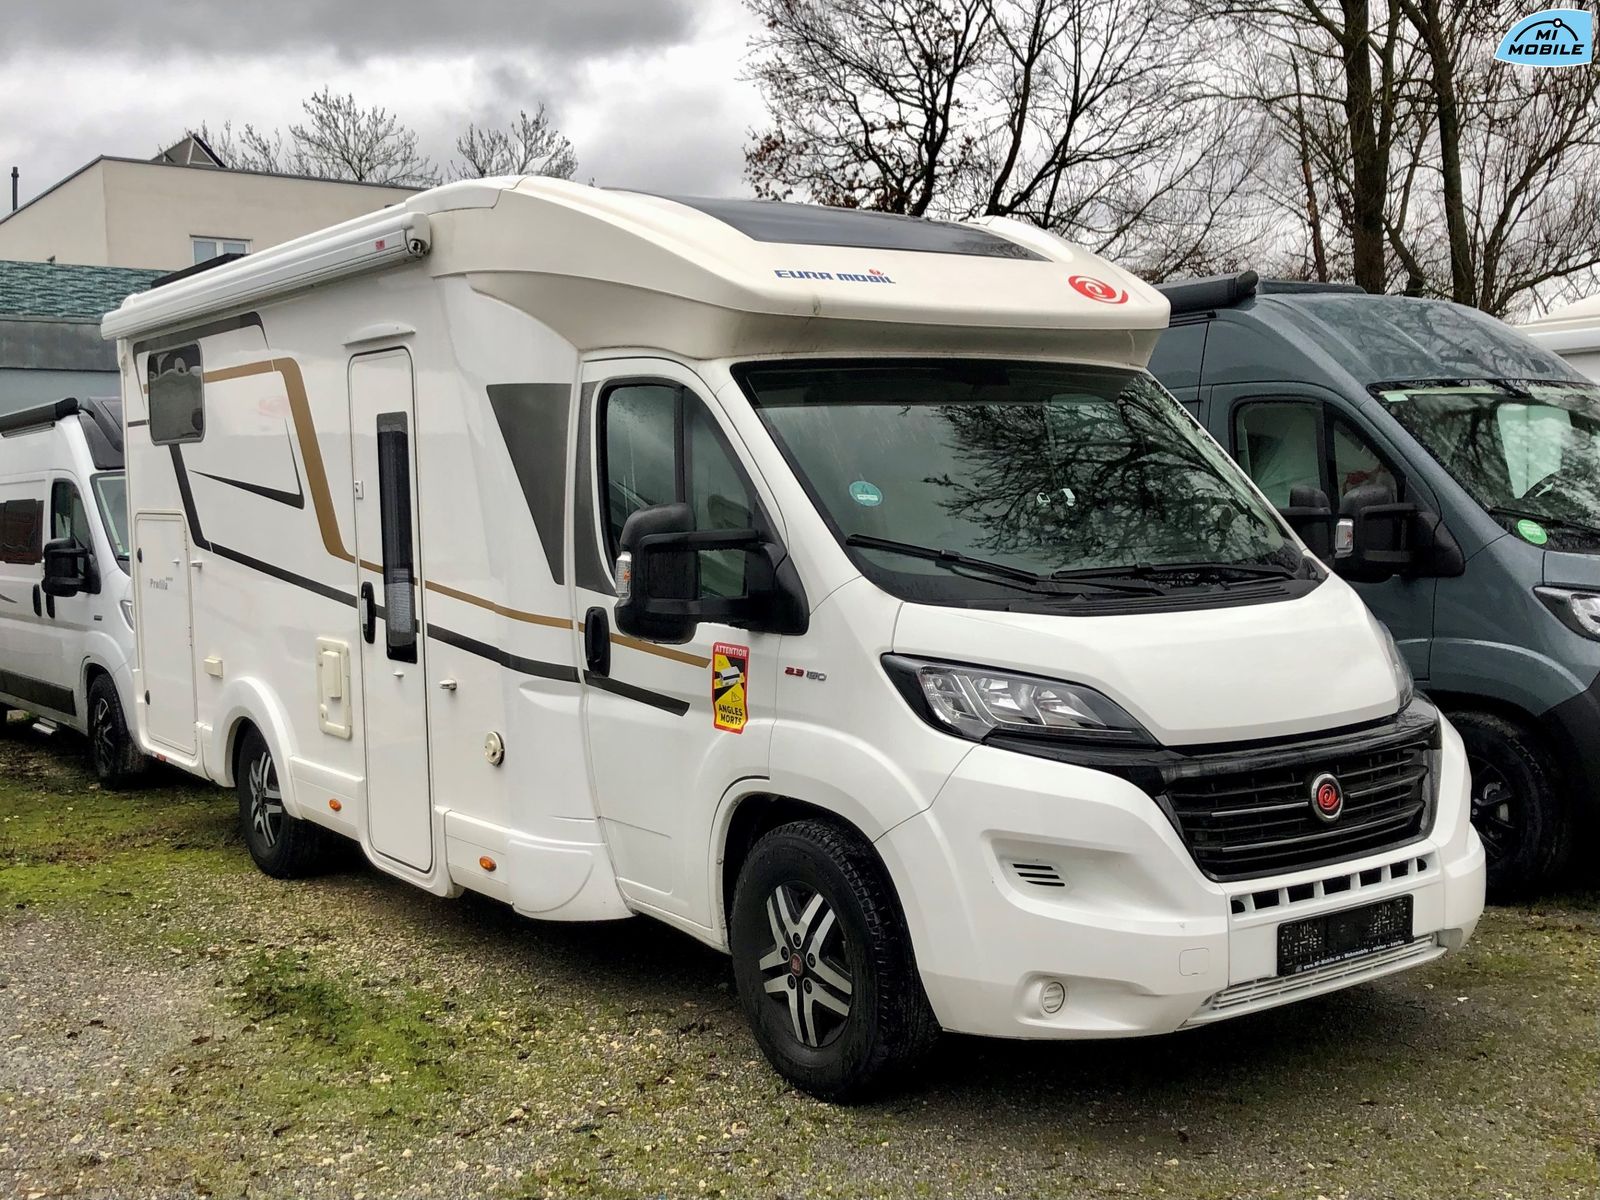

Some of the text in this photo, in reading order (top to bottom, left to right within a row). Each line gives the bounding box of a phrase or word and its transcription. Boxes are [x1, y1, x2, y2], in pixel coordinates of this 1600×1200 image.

[715, 645, 747, 656] ATTENTION
[718, 704, 743, 716] ANGLES
[720, 713, 742, 726] MORTS
